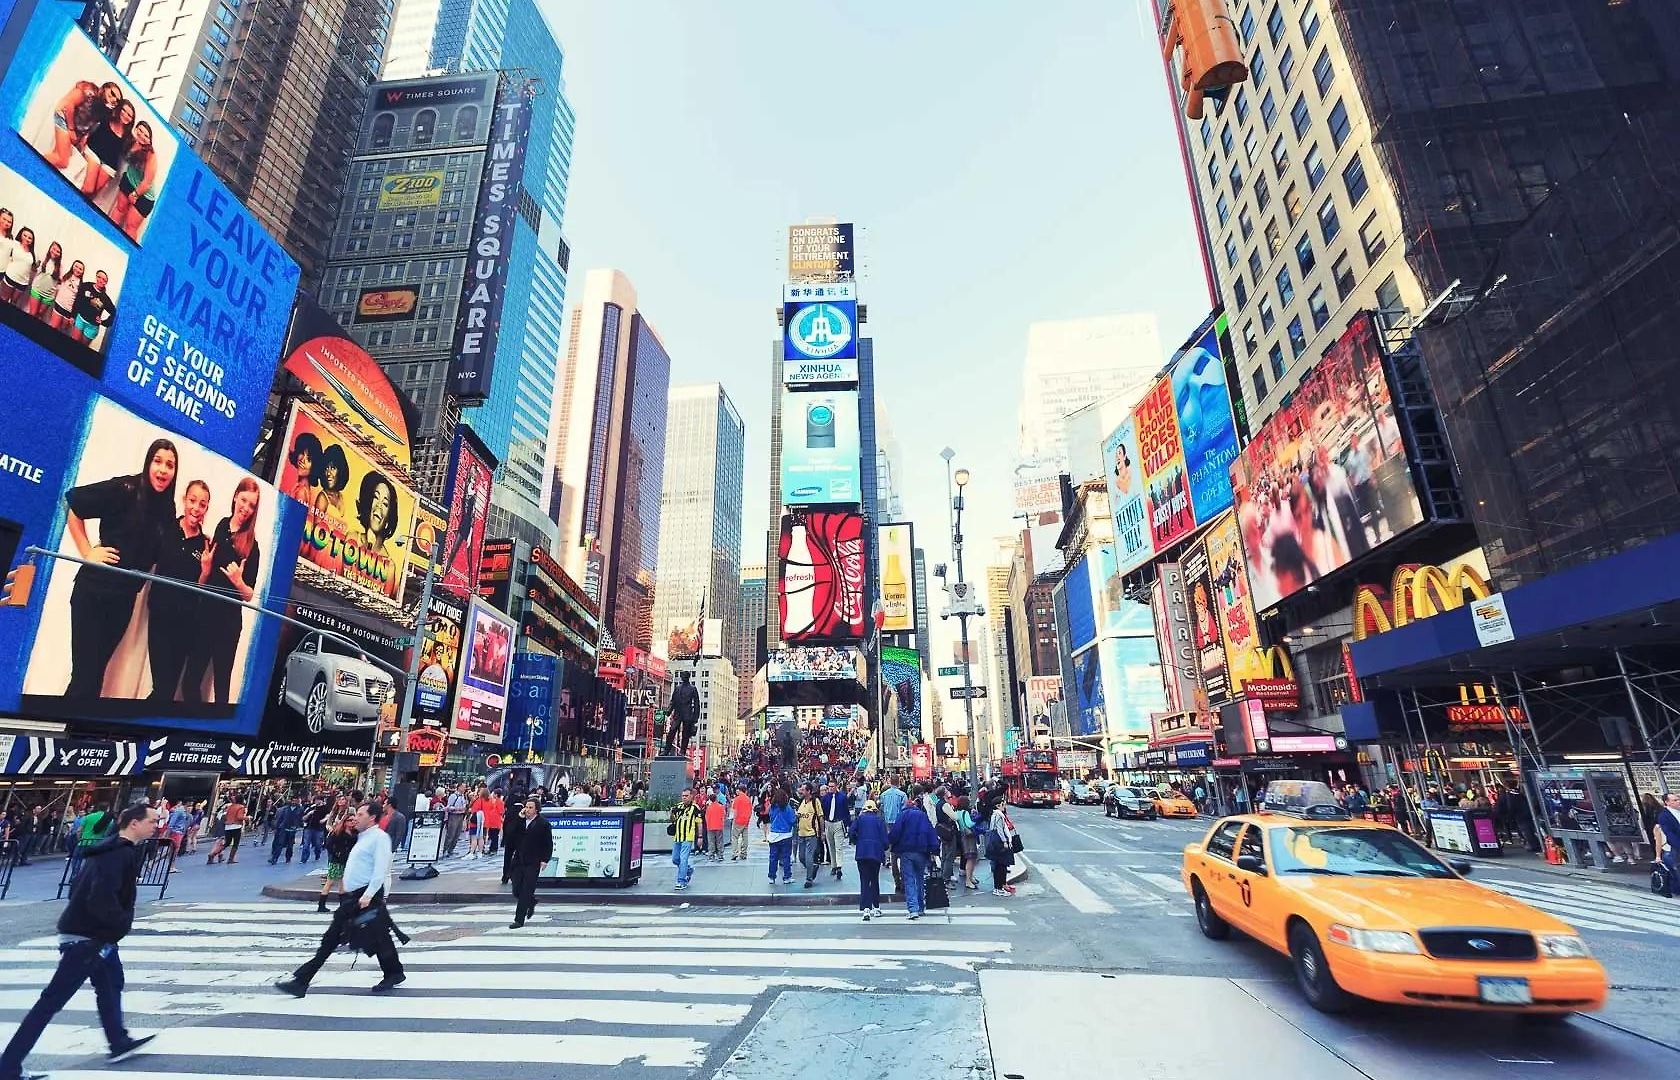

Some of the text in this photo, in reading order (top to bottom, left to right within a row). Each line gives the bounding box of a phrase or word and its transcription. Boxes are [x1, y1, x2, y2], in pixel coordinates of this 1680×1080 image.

[385, 87, 476, 102] W TIMES SQUARE
[390, 177, 436, 194] Z100
[185, 169, 281, 285] LEAVE
[462, 103, 521, 354] TIMES SQUARE
[792, 227, 839, 237] CONGRATS
[792, 235, 846, 245] ON DAY ONE
[792, 243, 831, 252] OF YOUR
[189, 222, 267, 328] YOUR
[156, 262, 256, 361] MARK
[143, 314, 225, 387] GET YOUR
[320, 345, 356, 382] IMPORTED
[800, 364, 842, 373] XINHUA
[127, 360, 206, 426] OF FAME.
[136, 337, 237, 419] 15 SECONDS
[458, 371, 477, 380] NYC
[790, 373, 815, 381] NEWS
[1135, 379, 1172, 428] THE
[1139, 404, 1173, 444] CROWD
[1141, 418, 1176, 460] GOES
[1144, 433, 1181, 479] WILD!
[1191, 444, 1237, 485] PHANTOM
[296, 606, 335, 626] CHRYSLER
[338, 621, 351, 632] 300
[353, 627, 379, 643] MOTOWN
[433, 599, 447, 617] JOY
[1168, 572, 1196, 679] PALACE
[1247, 684, 1297, 692] McDonald's
[77, 758, 103, 767] OPEN
[80, 748, 109, 758] WE'RE
[168, 752, 223, 764] ENTER HERE
